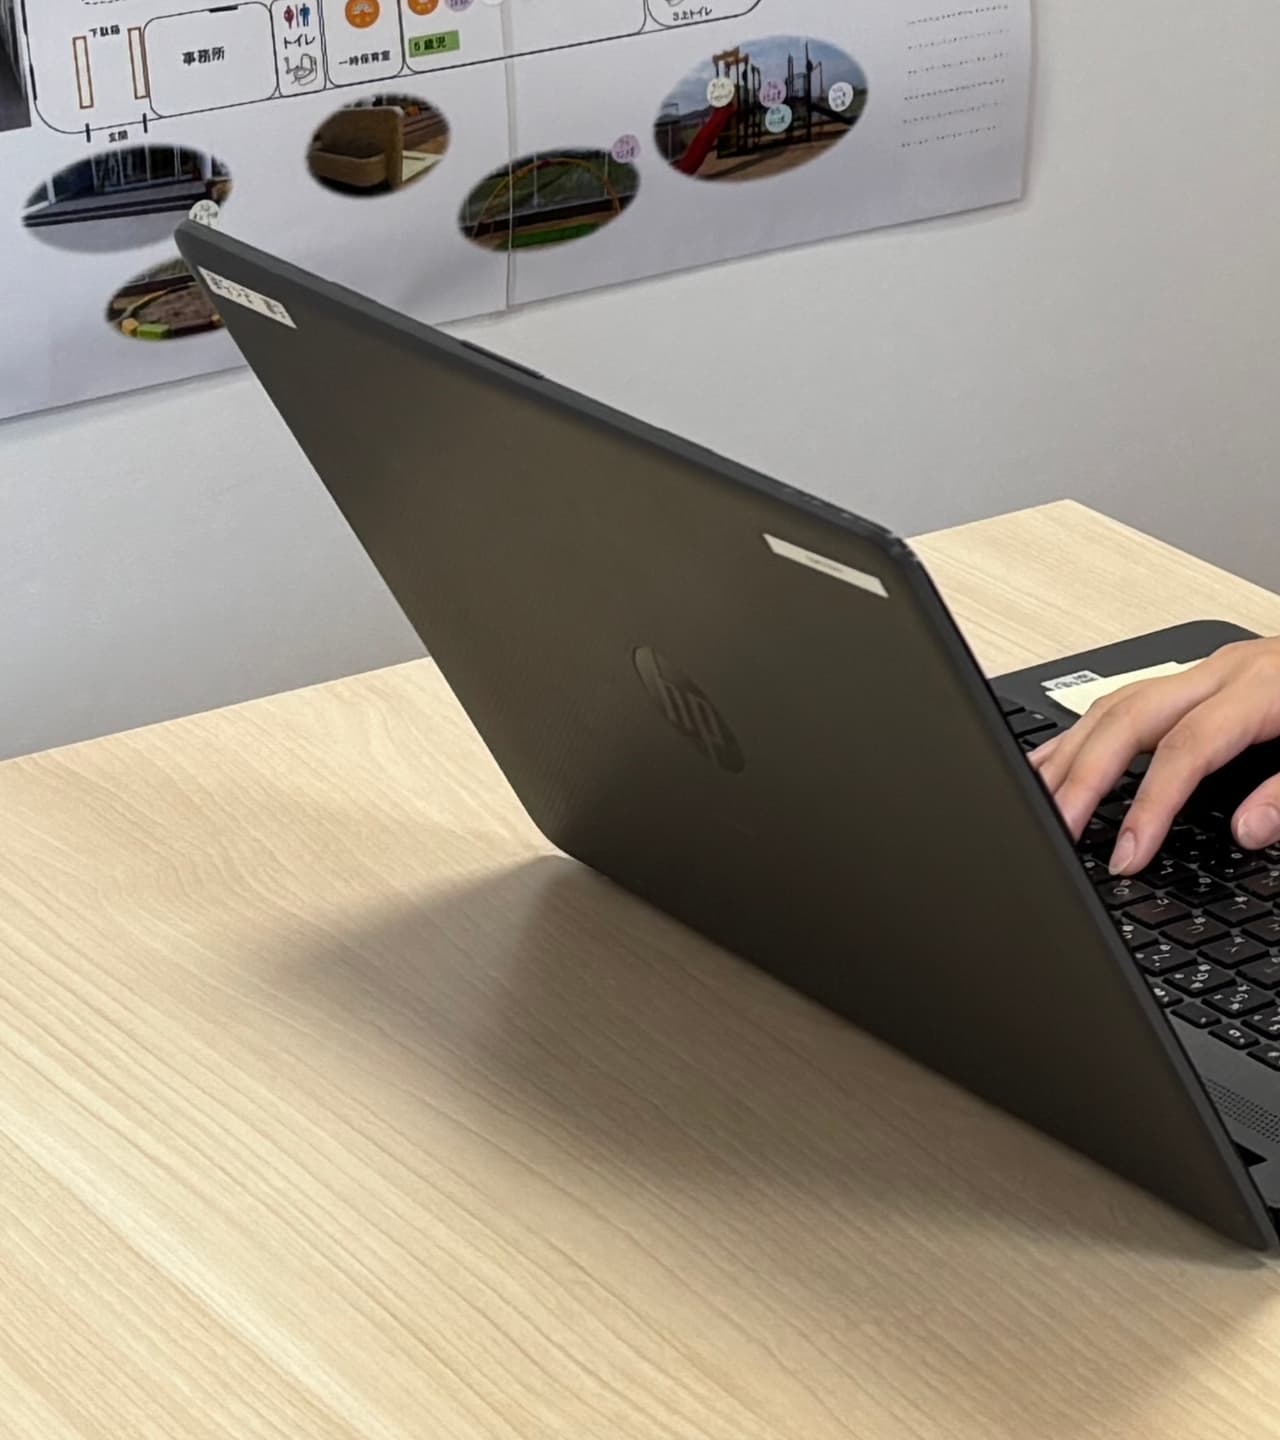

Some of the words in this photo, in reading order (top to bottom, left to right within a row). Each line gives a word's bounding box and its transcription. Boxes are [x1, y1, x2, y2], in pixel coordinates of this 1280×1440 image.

[283, 33, 316, 48] トイレ
[181, 47, 226, 65] 事務所
